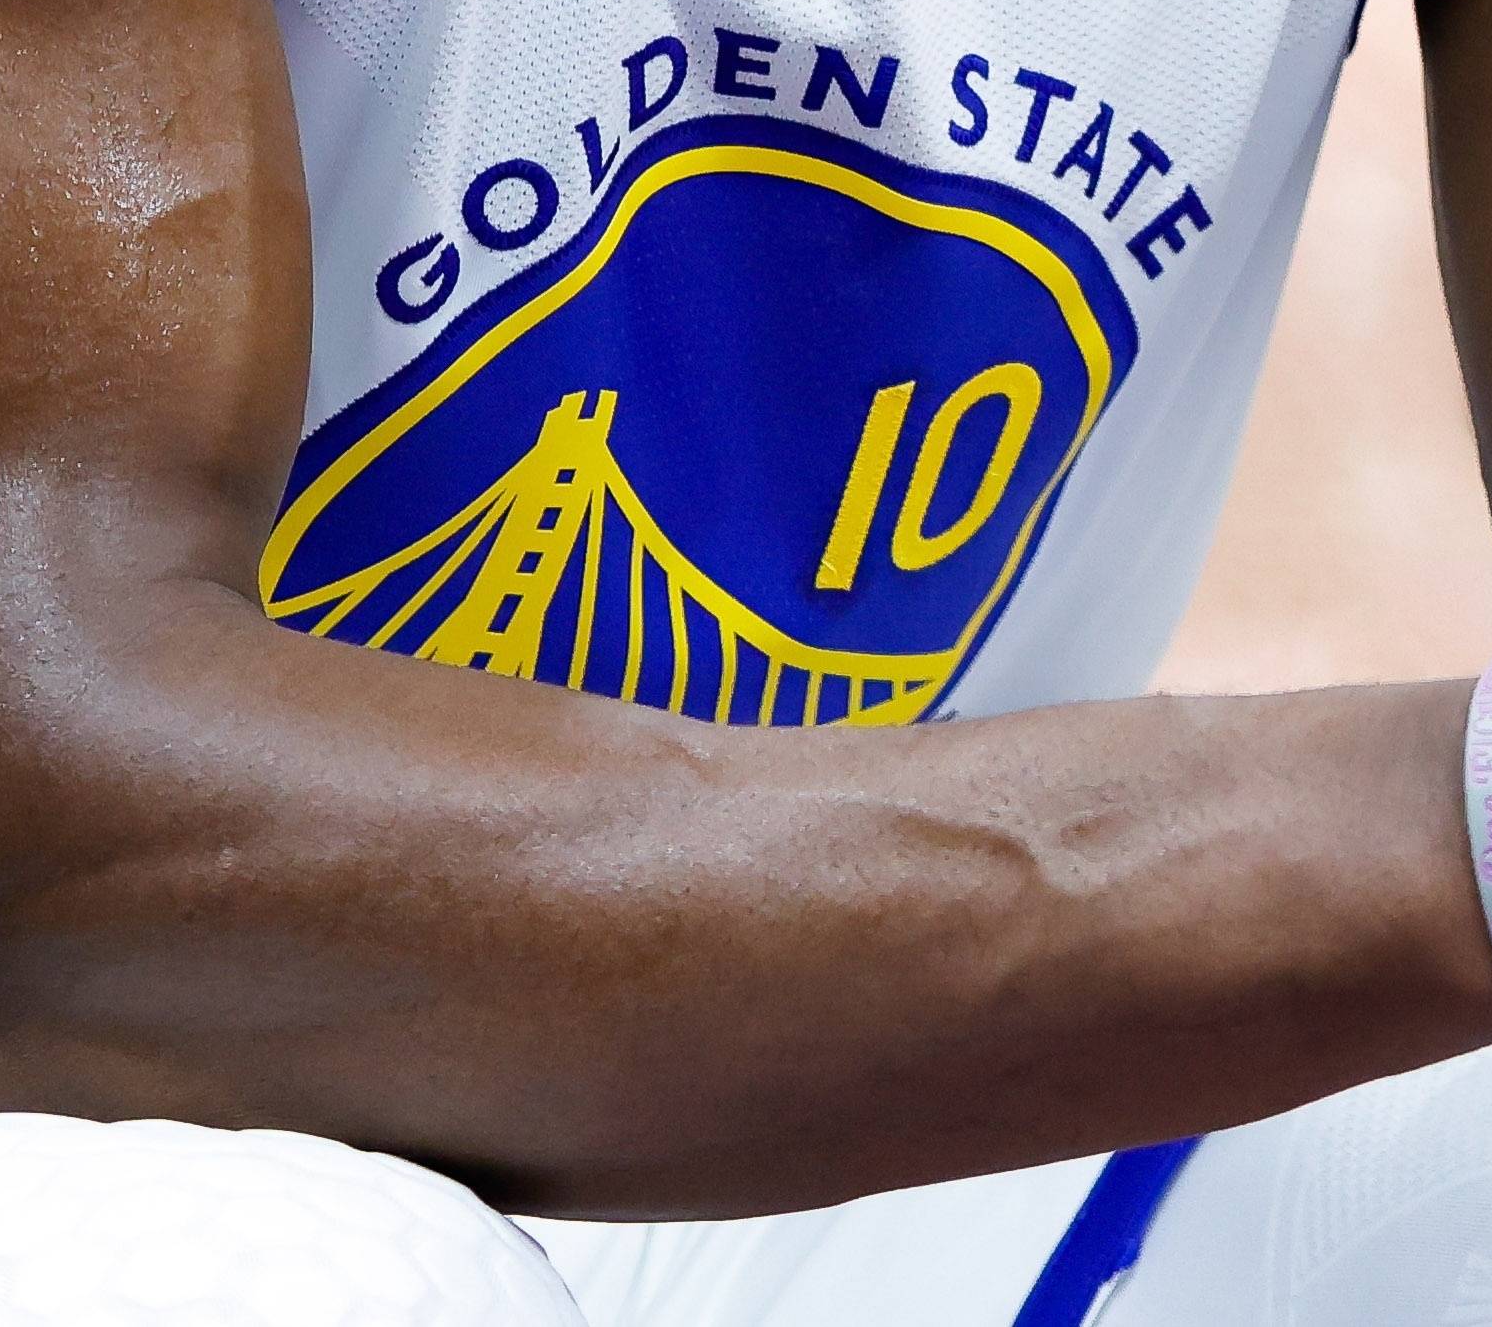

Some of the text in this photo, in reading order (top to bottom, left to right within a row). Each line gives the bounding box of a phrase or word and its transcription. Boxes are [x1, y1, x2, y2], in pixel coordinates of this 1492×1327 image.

[375, 26, 1214, 324] GOLDEN STATE
[813, 360, 1044, 592] 10
